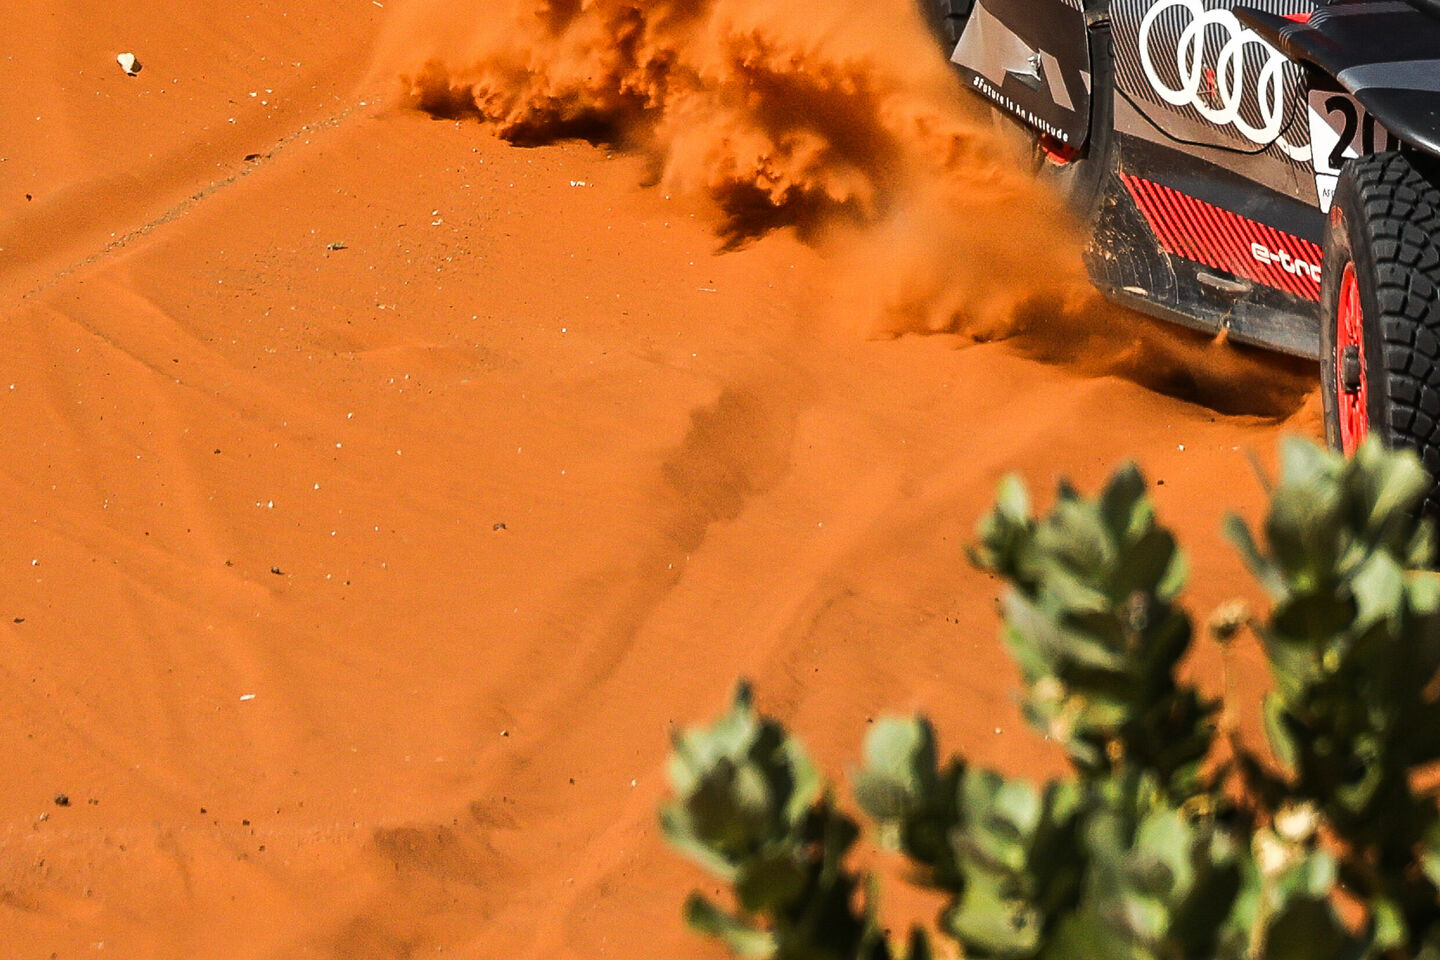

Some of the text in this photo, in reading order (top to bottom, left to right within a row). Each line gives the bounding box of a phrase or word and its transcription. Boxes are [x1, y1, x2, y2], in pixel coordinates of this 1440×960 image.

[1006, 97, 1014, 111] Is
[1015, 104, 1026, 119] An
[1028, 112, 1069, 142] Attitude
[1324, 95, 1401, 169] 20
[1251, 242, 1322, 283] e-tro
